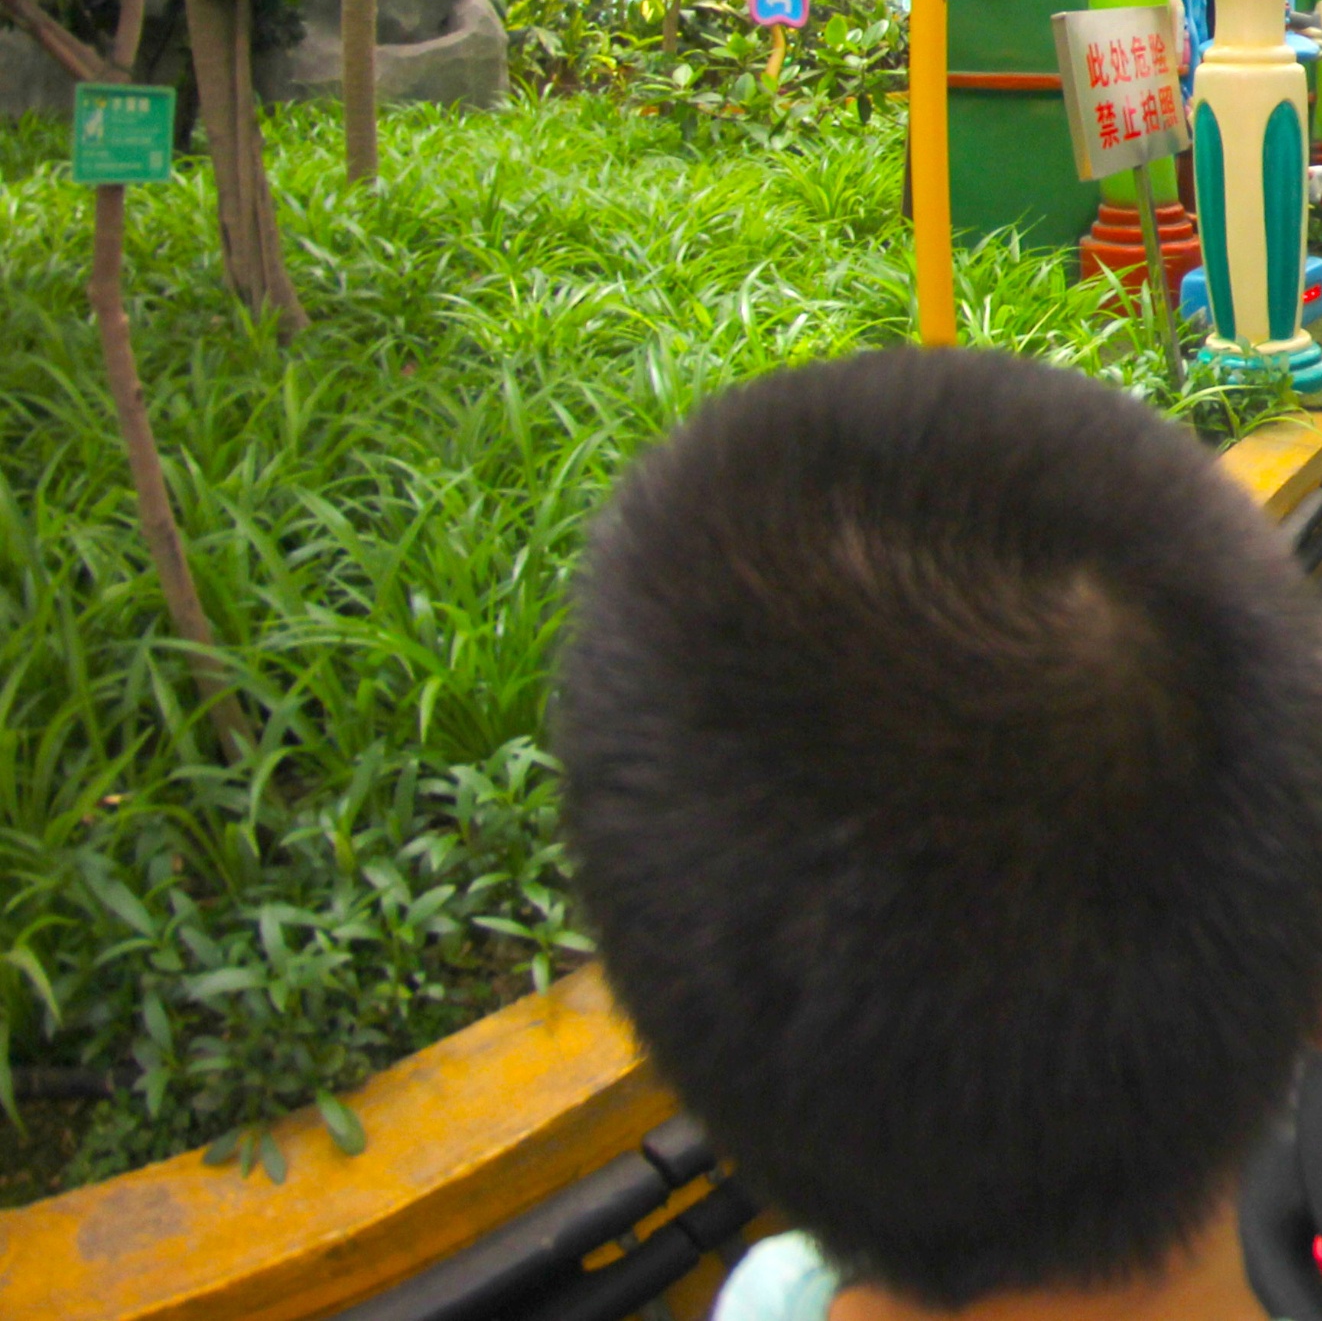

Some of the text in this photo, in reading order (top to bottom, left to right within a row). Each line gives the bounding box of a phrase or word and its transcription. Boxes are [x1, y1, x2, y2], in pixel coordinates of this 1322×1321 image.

[1086, 33, 1169, 88] 此处危险
[1094, 84, 1179, 150] 禁止拍照
